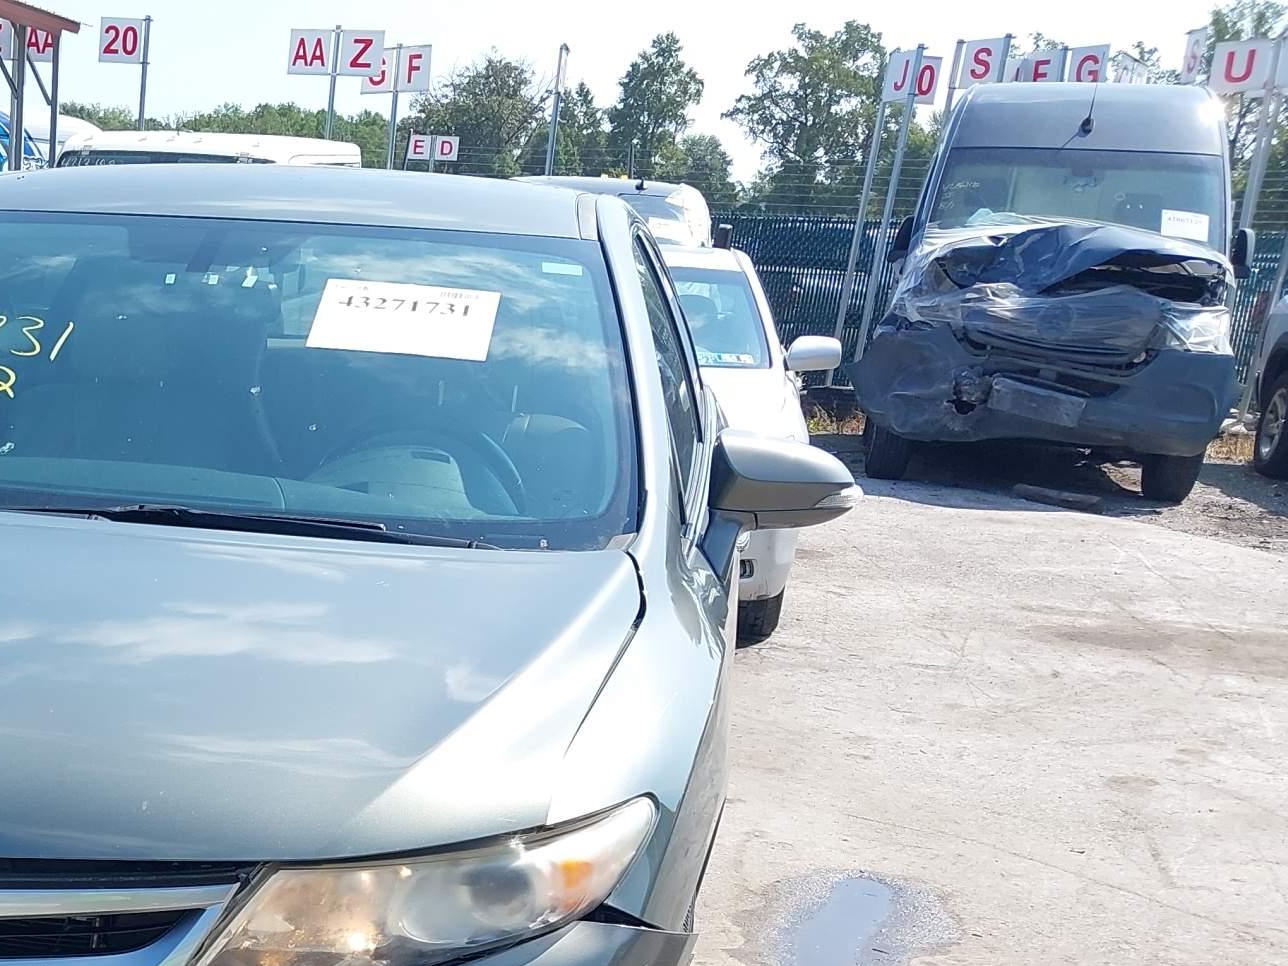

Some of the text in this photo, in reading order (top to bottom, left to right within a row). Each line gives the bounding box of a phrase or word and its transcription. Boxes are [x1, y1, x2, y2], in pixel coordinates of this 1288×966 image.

[103, 24, 138, 56] 20
[292, 37, 325, 67] AA
[349, 38, 374, 68] Z
[407, 53, 422, 84] F
[893, 59, 910, 92] J
[969, 47, 993, 80] S
[1076, 54, 1099, 83] G
[1224, 48, 1257, 84] U
[413, 139, 425, 155] E
[439, 140, 453, 156] D
[338, 294, 471, 318] 43271731
